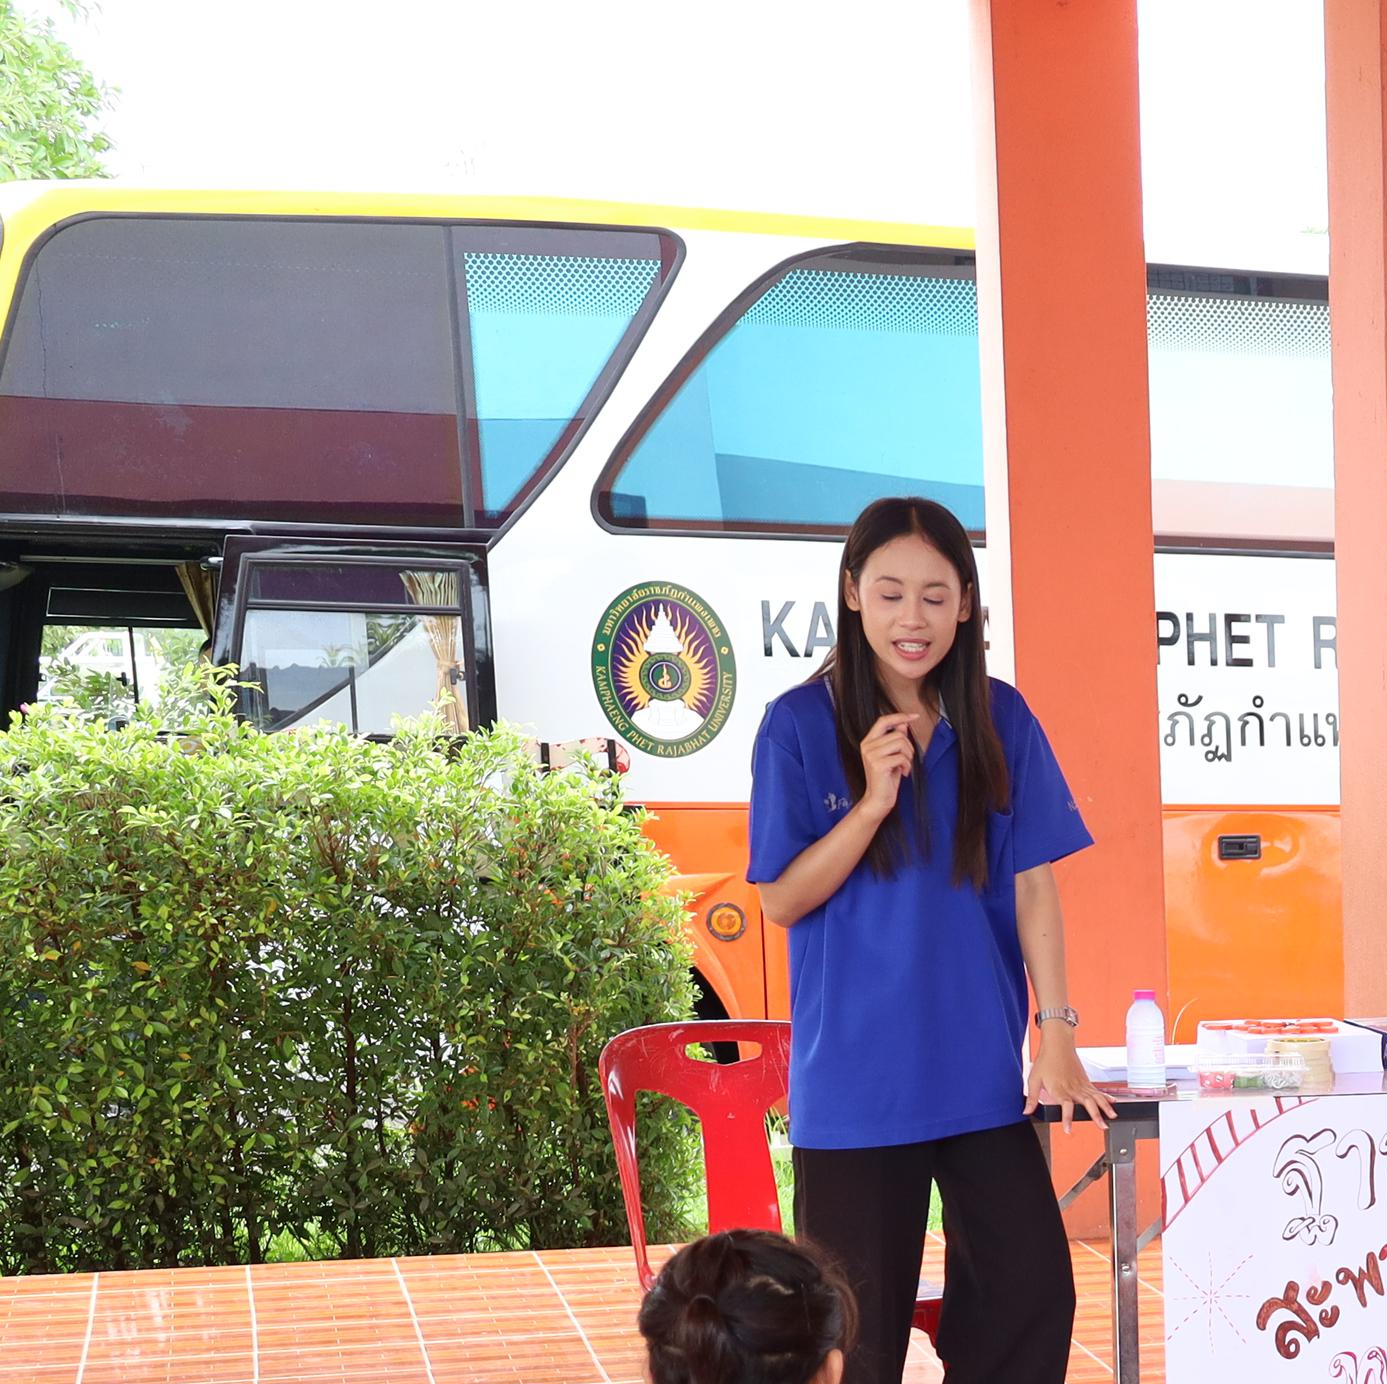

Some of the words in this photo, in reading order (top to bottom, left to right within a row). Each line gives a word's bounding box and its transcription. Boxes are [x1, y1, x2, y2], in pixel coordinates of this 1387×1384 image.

[1156, 611, 1286, 667] PHET
[596, 665, 629, 731] KAMPHAENG
[627, 730, 655, 751] PHET
[656, 731, 711, 756] RAJABHAT
[708, 671, 733, 732] UNIVERSITY
